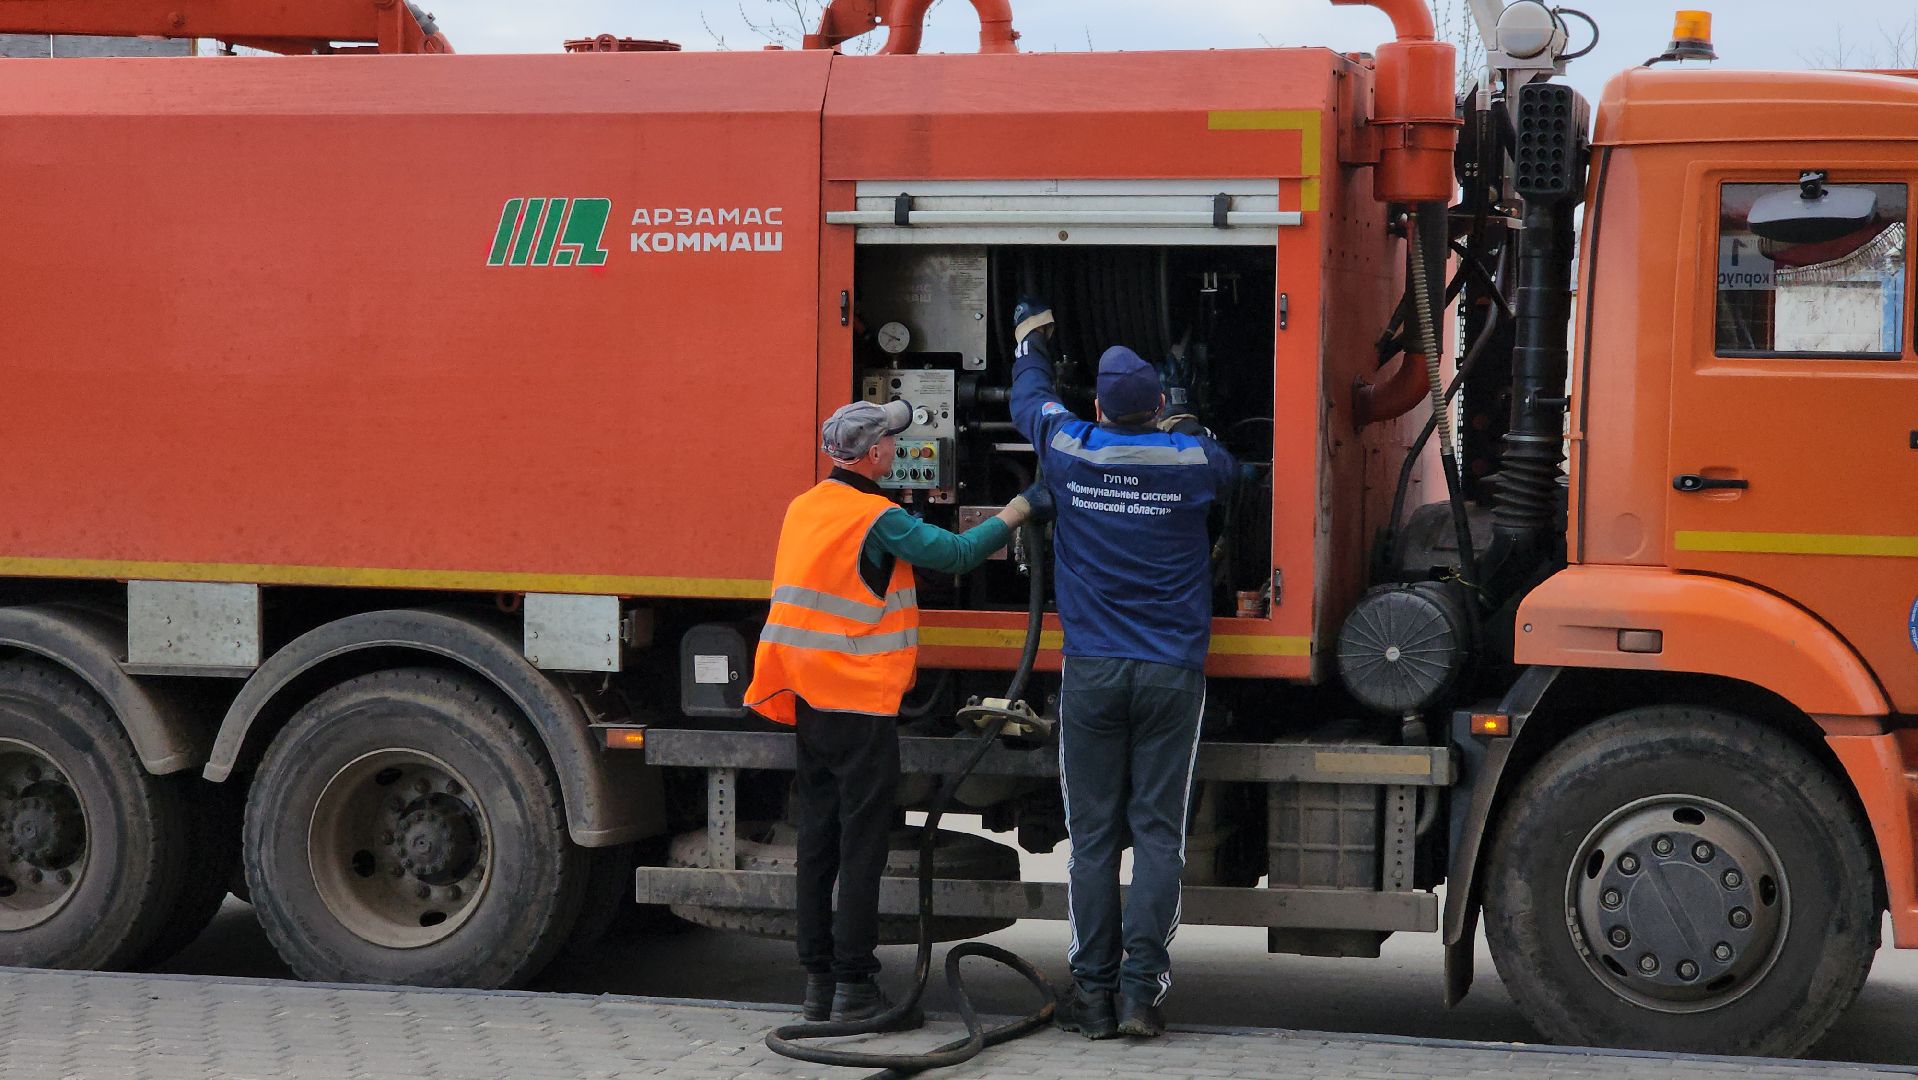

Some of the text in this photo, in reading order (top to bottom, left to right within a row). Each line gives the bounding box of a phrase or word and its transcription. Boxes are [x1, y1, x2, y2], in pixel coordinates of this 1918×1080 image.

[632, 207, 783, 226] АРЗАМАС
[631, 232, 783, 252] КОММАШ
[1103, 474, 1139, 486] ГУП МО
[1066, 481, 1182, 502] «Коммунальные системы
[1072, 496, 1172, 515] Московской области»
